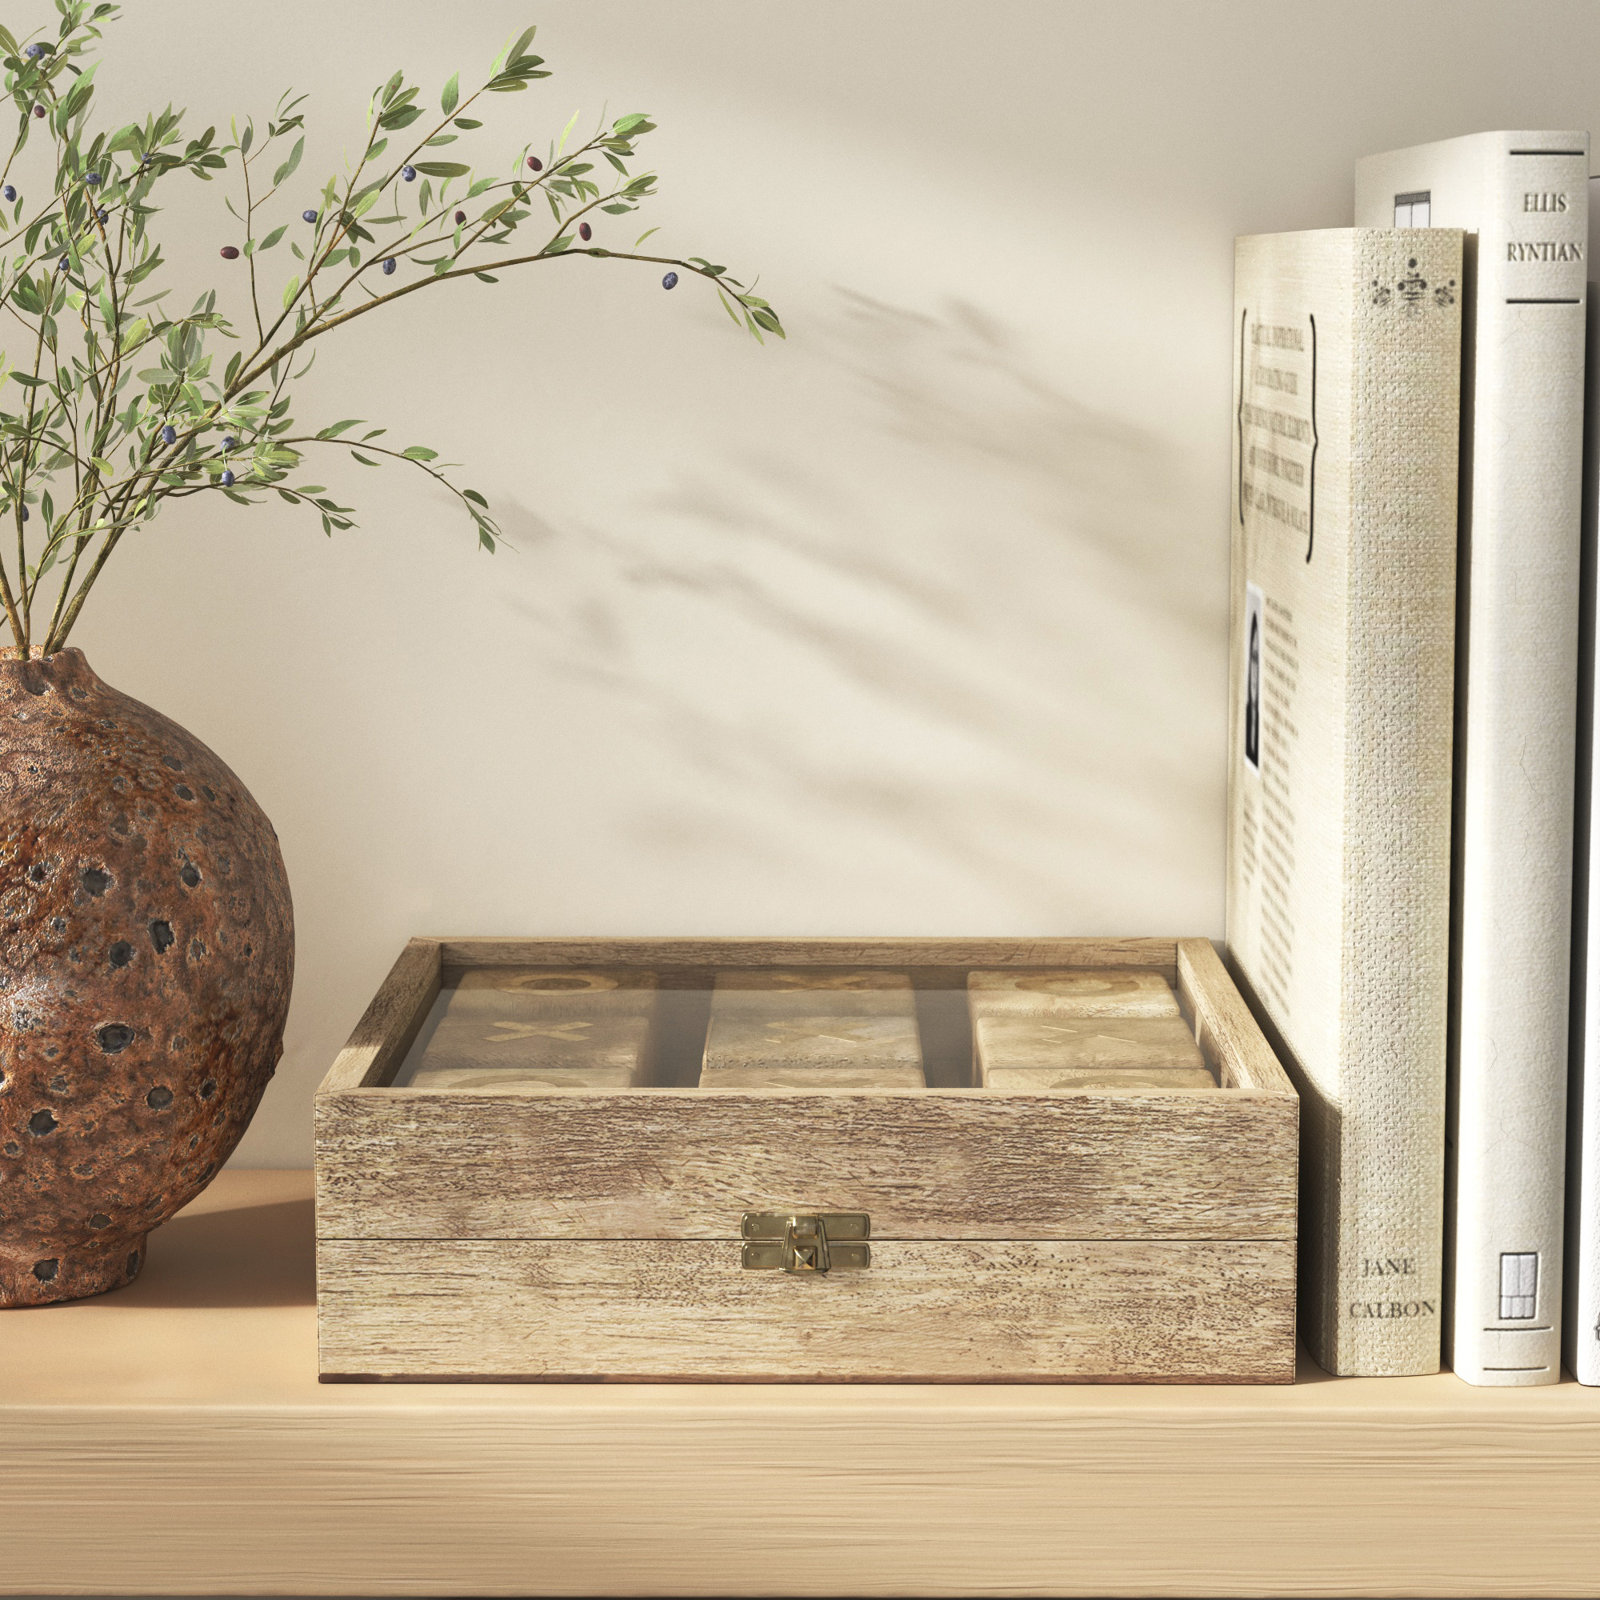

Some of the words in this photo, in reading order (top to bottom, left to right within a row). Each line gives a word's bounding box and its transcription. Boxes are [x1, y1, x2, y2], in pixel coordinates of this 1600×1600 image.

[1523, 192, 1568, 213] ELLIS
[1507, 242, 1583, 262] RYNTIAN
[1361, 1258, 1416, 1278] JANE
[1349, 1300, 1436, 1319] CALBON
